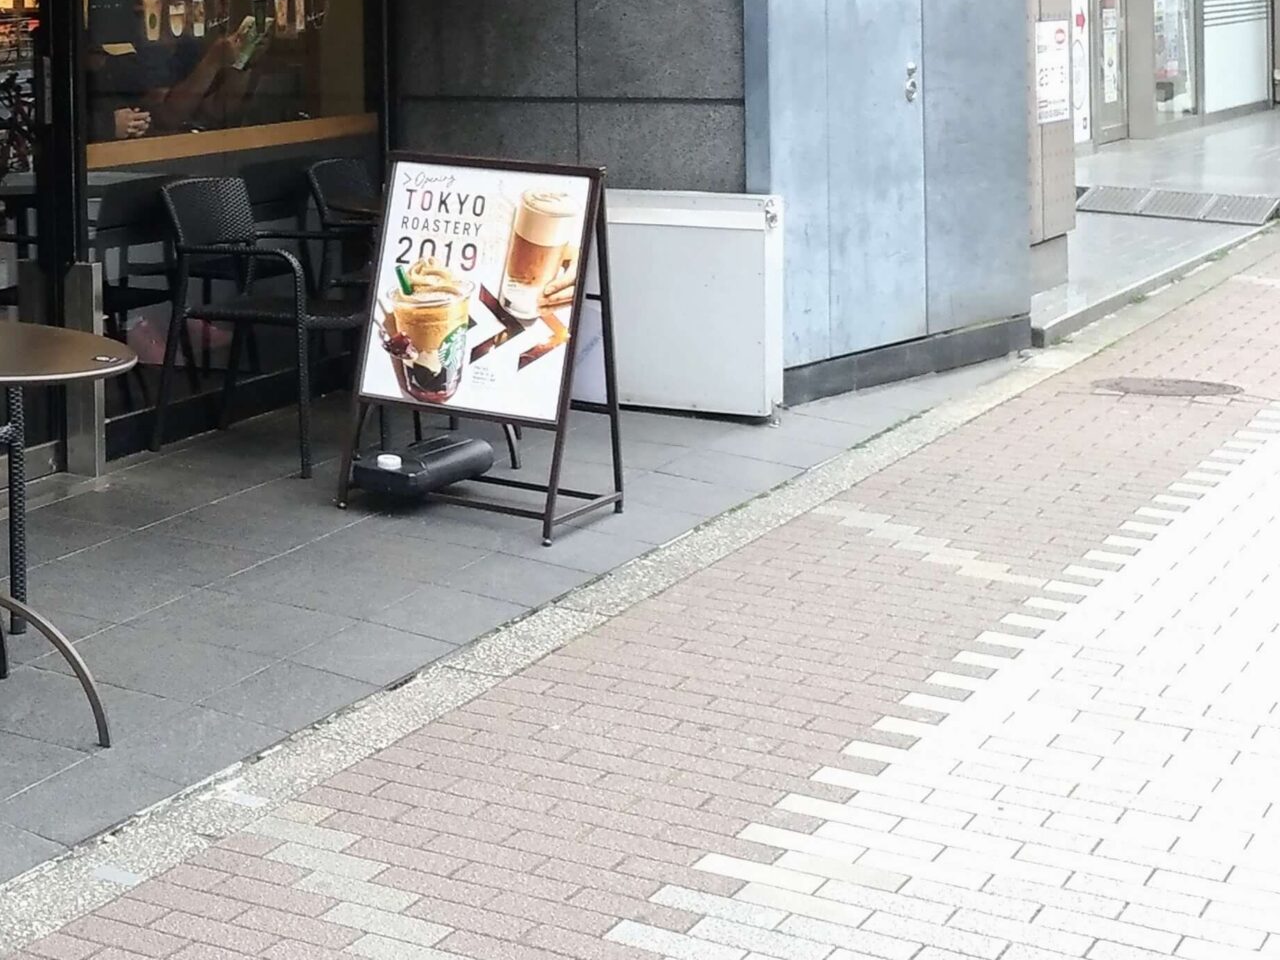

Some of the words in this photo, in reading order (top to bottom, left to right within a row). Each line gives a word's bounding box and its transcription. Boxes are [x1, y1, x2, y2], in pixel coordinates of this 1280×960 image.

[406, 188, 486, 217] TOKYO
[401, 215, 482, 237] ROASTERY
[395, 236, 478, 272] 2019
